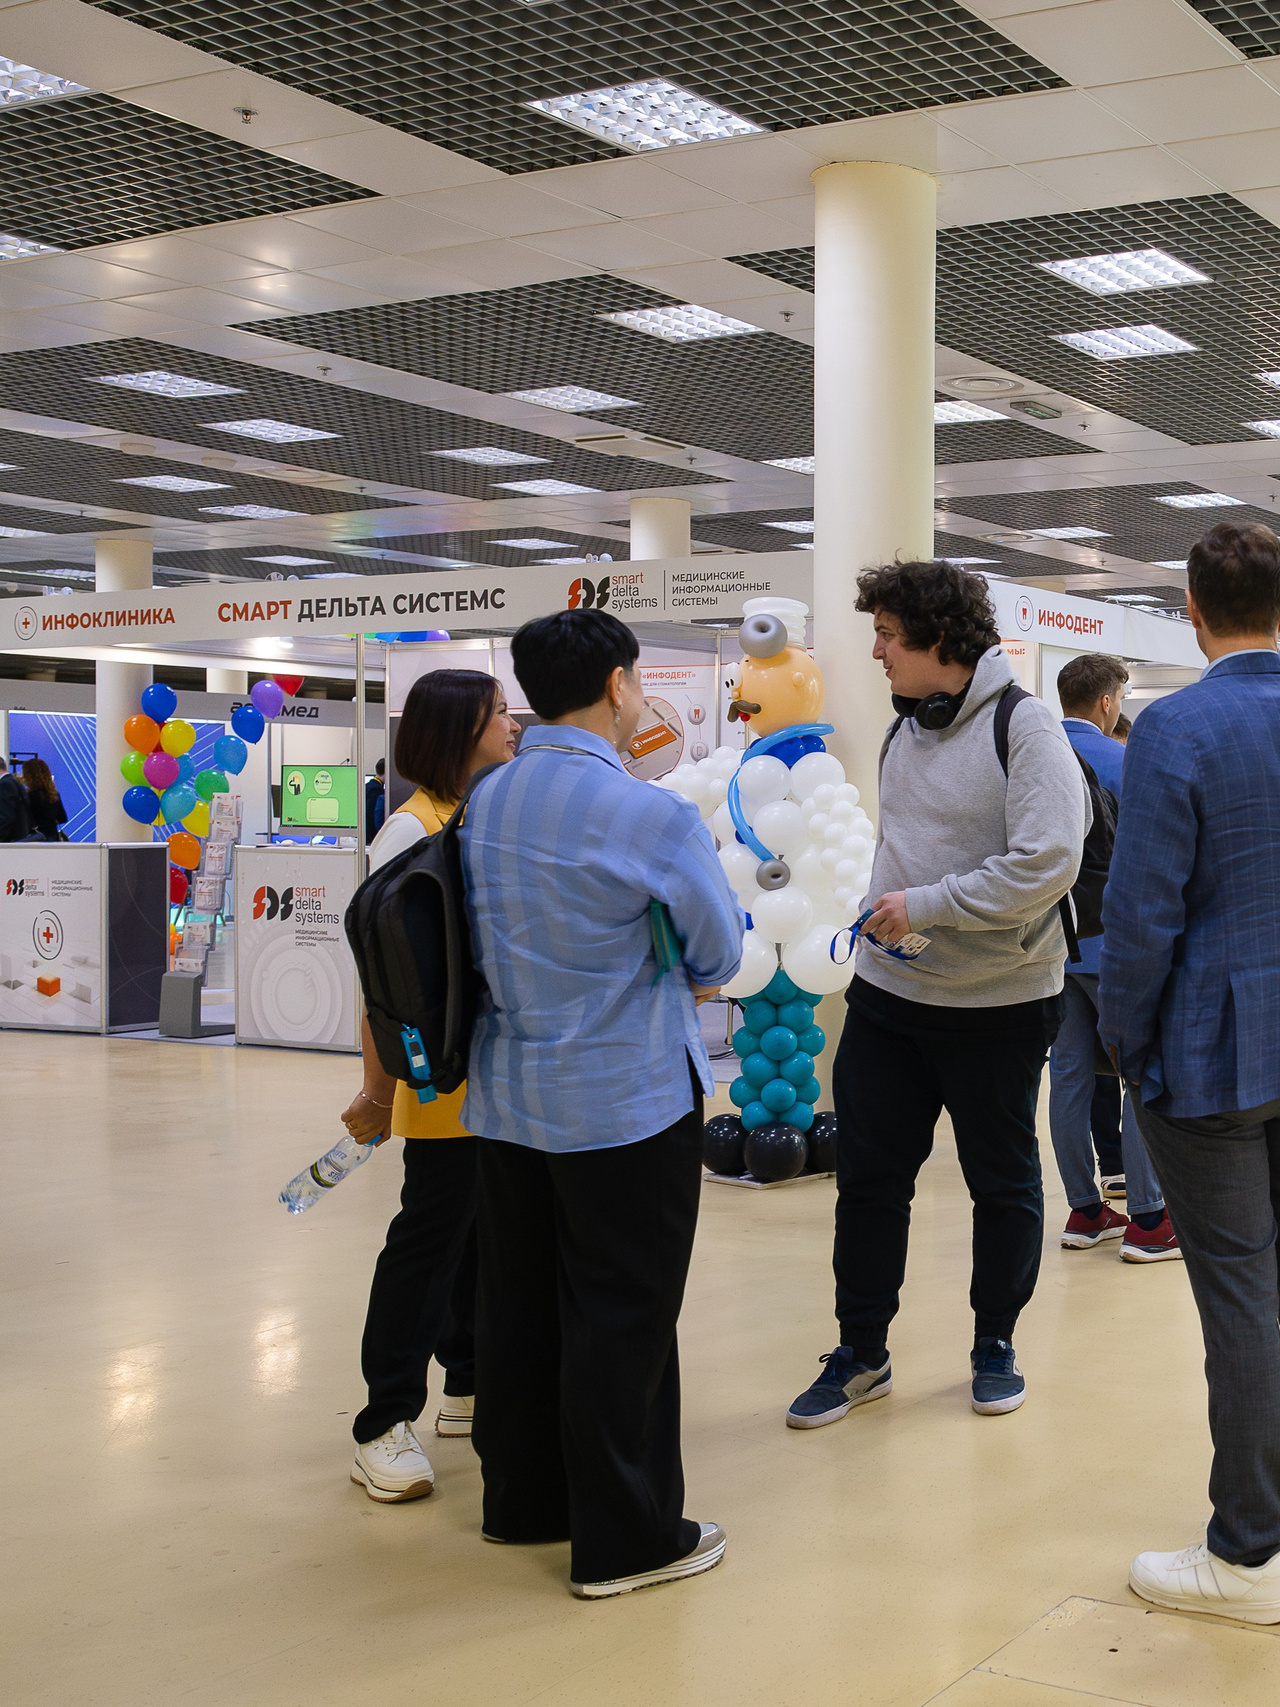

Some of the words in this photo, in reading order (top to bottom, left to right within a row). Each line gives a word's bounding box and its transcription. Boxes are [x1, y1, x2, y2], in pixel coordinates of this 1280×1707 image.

[611, 572, 644, 585] smart
[671, 571, 745, 584] МЕДИЦИНСКИЕ
[611, 584, 640, 597] delta
[671, 582, 771, 595] ИНФОРМАЦИОННЫЕ
[217, 600, 292, 622] СМАРТ
[298, 595, 387, 623] ДЕЛЬТА
[392, 588, 506, 615] СИСТЕМС
[611, 597, 658, 612] systems
[671, 597, 718, 607] СИСТЕМЫ
[42, 607, 176, 631] ИНФОКЛИНИКА
[1038, 609, 1104, 635] ИНФОДЕНТ
[295, 885, 326, 898] smart
[295, 897, 322, 910] delta
[295, 911, 340, 926] systems
